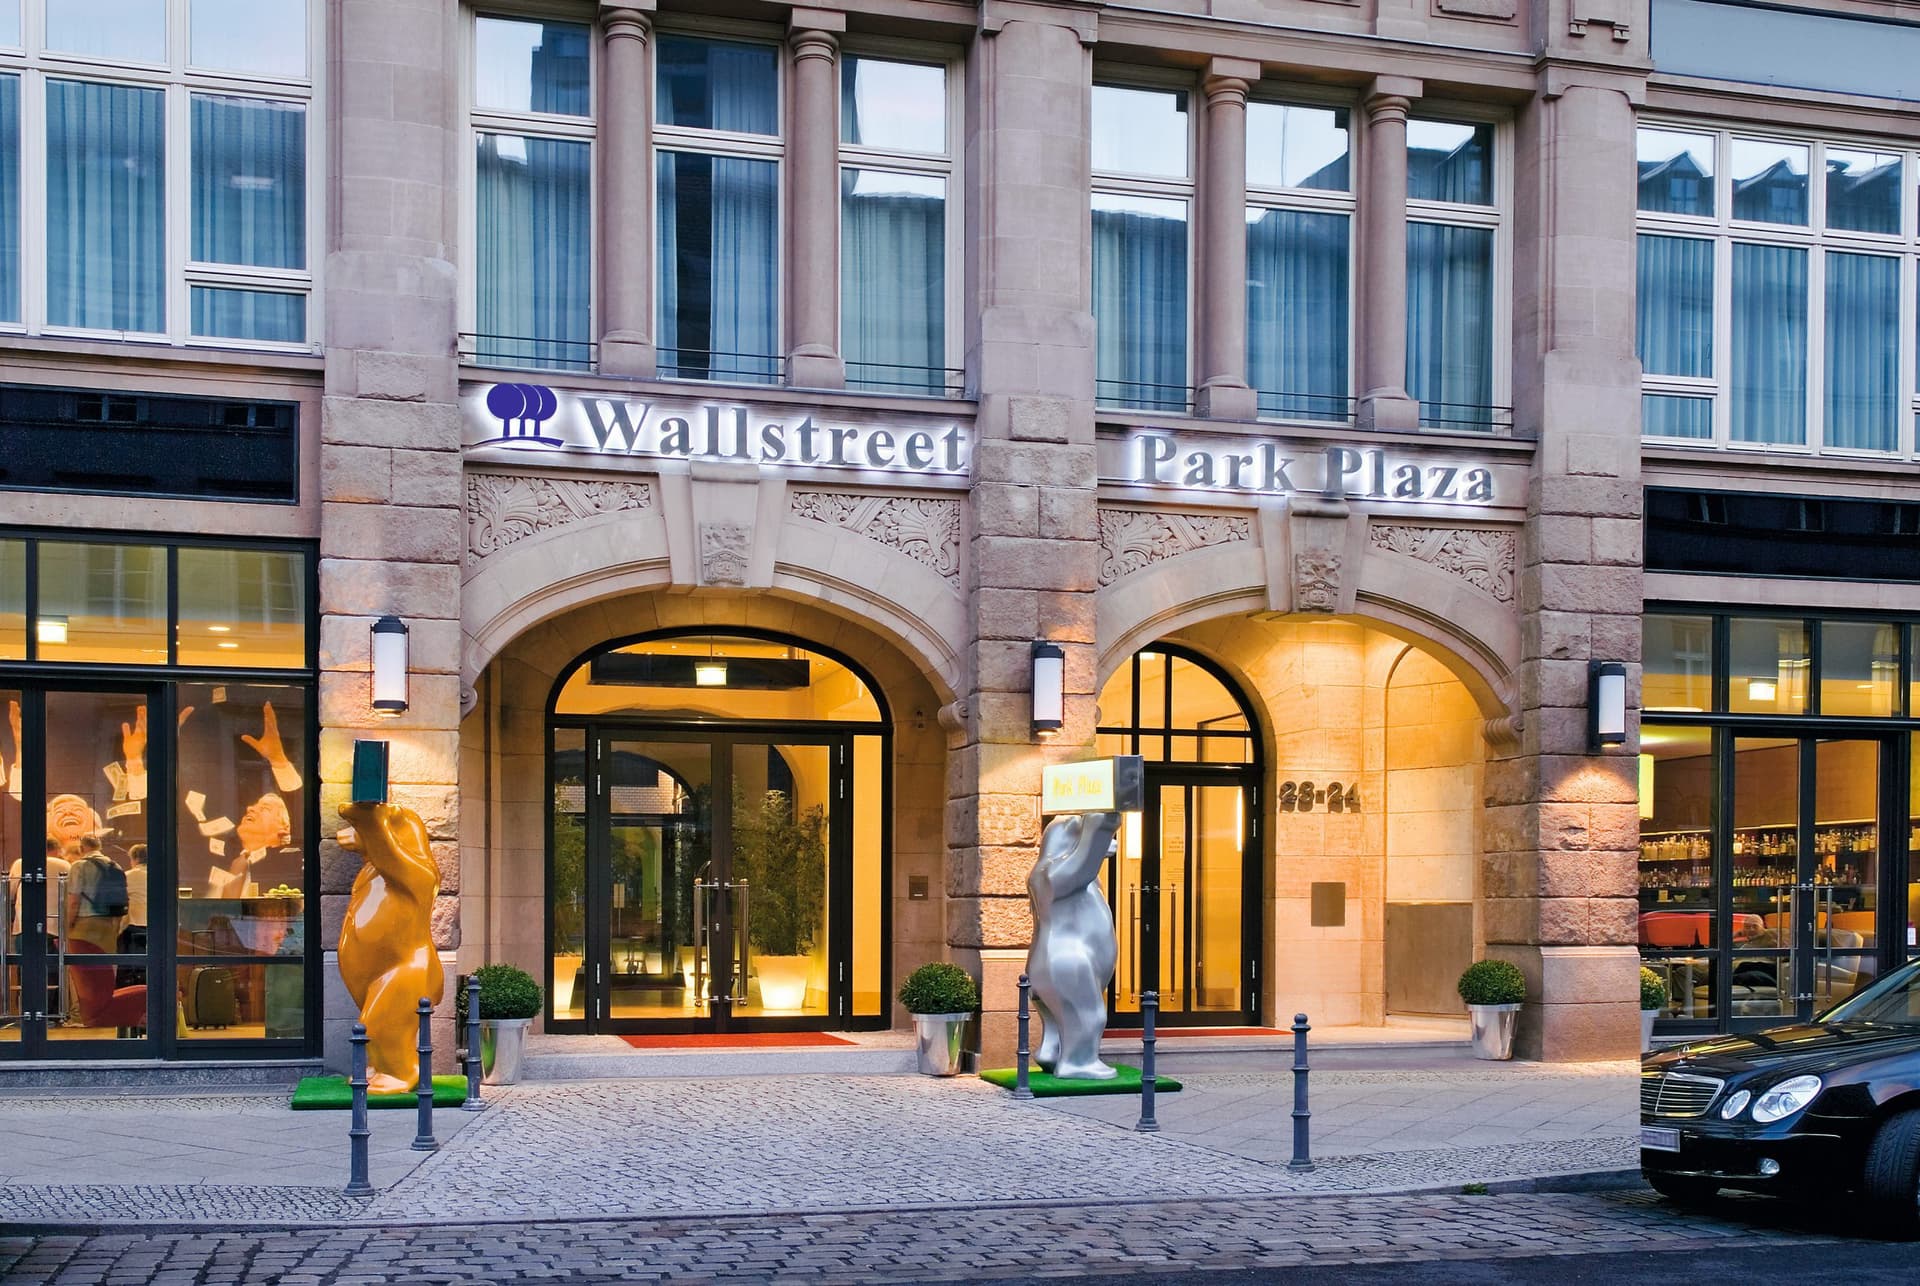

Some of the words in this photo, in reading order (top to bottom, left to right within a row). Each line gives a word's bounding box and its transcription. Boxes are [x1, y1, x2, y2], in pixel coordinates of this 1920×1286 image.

[579, 397, 967, 472] Wallstreet
[1135, 433, 1296, 493] Park
[1323, 445, 1494, 501] Plaza
